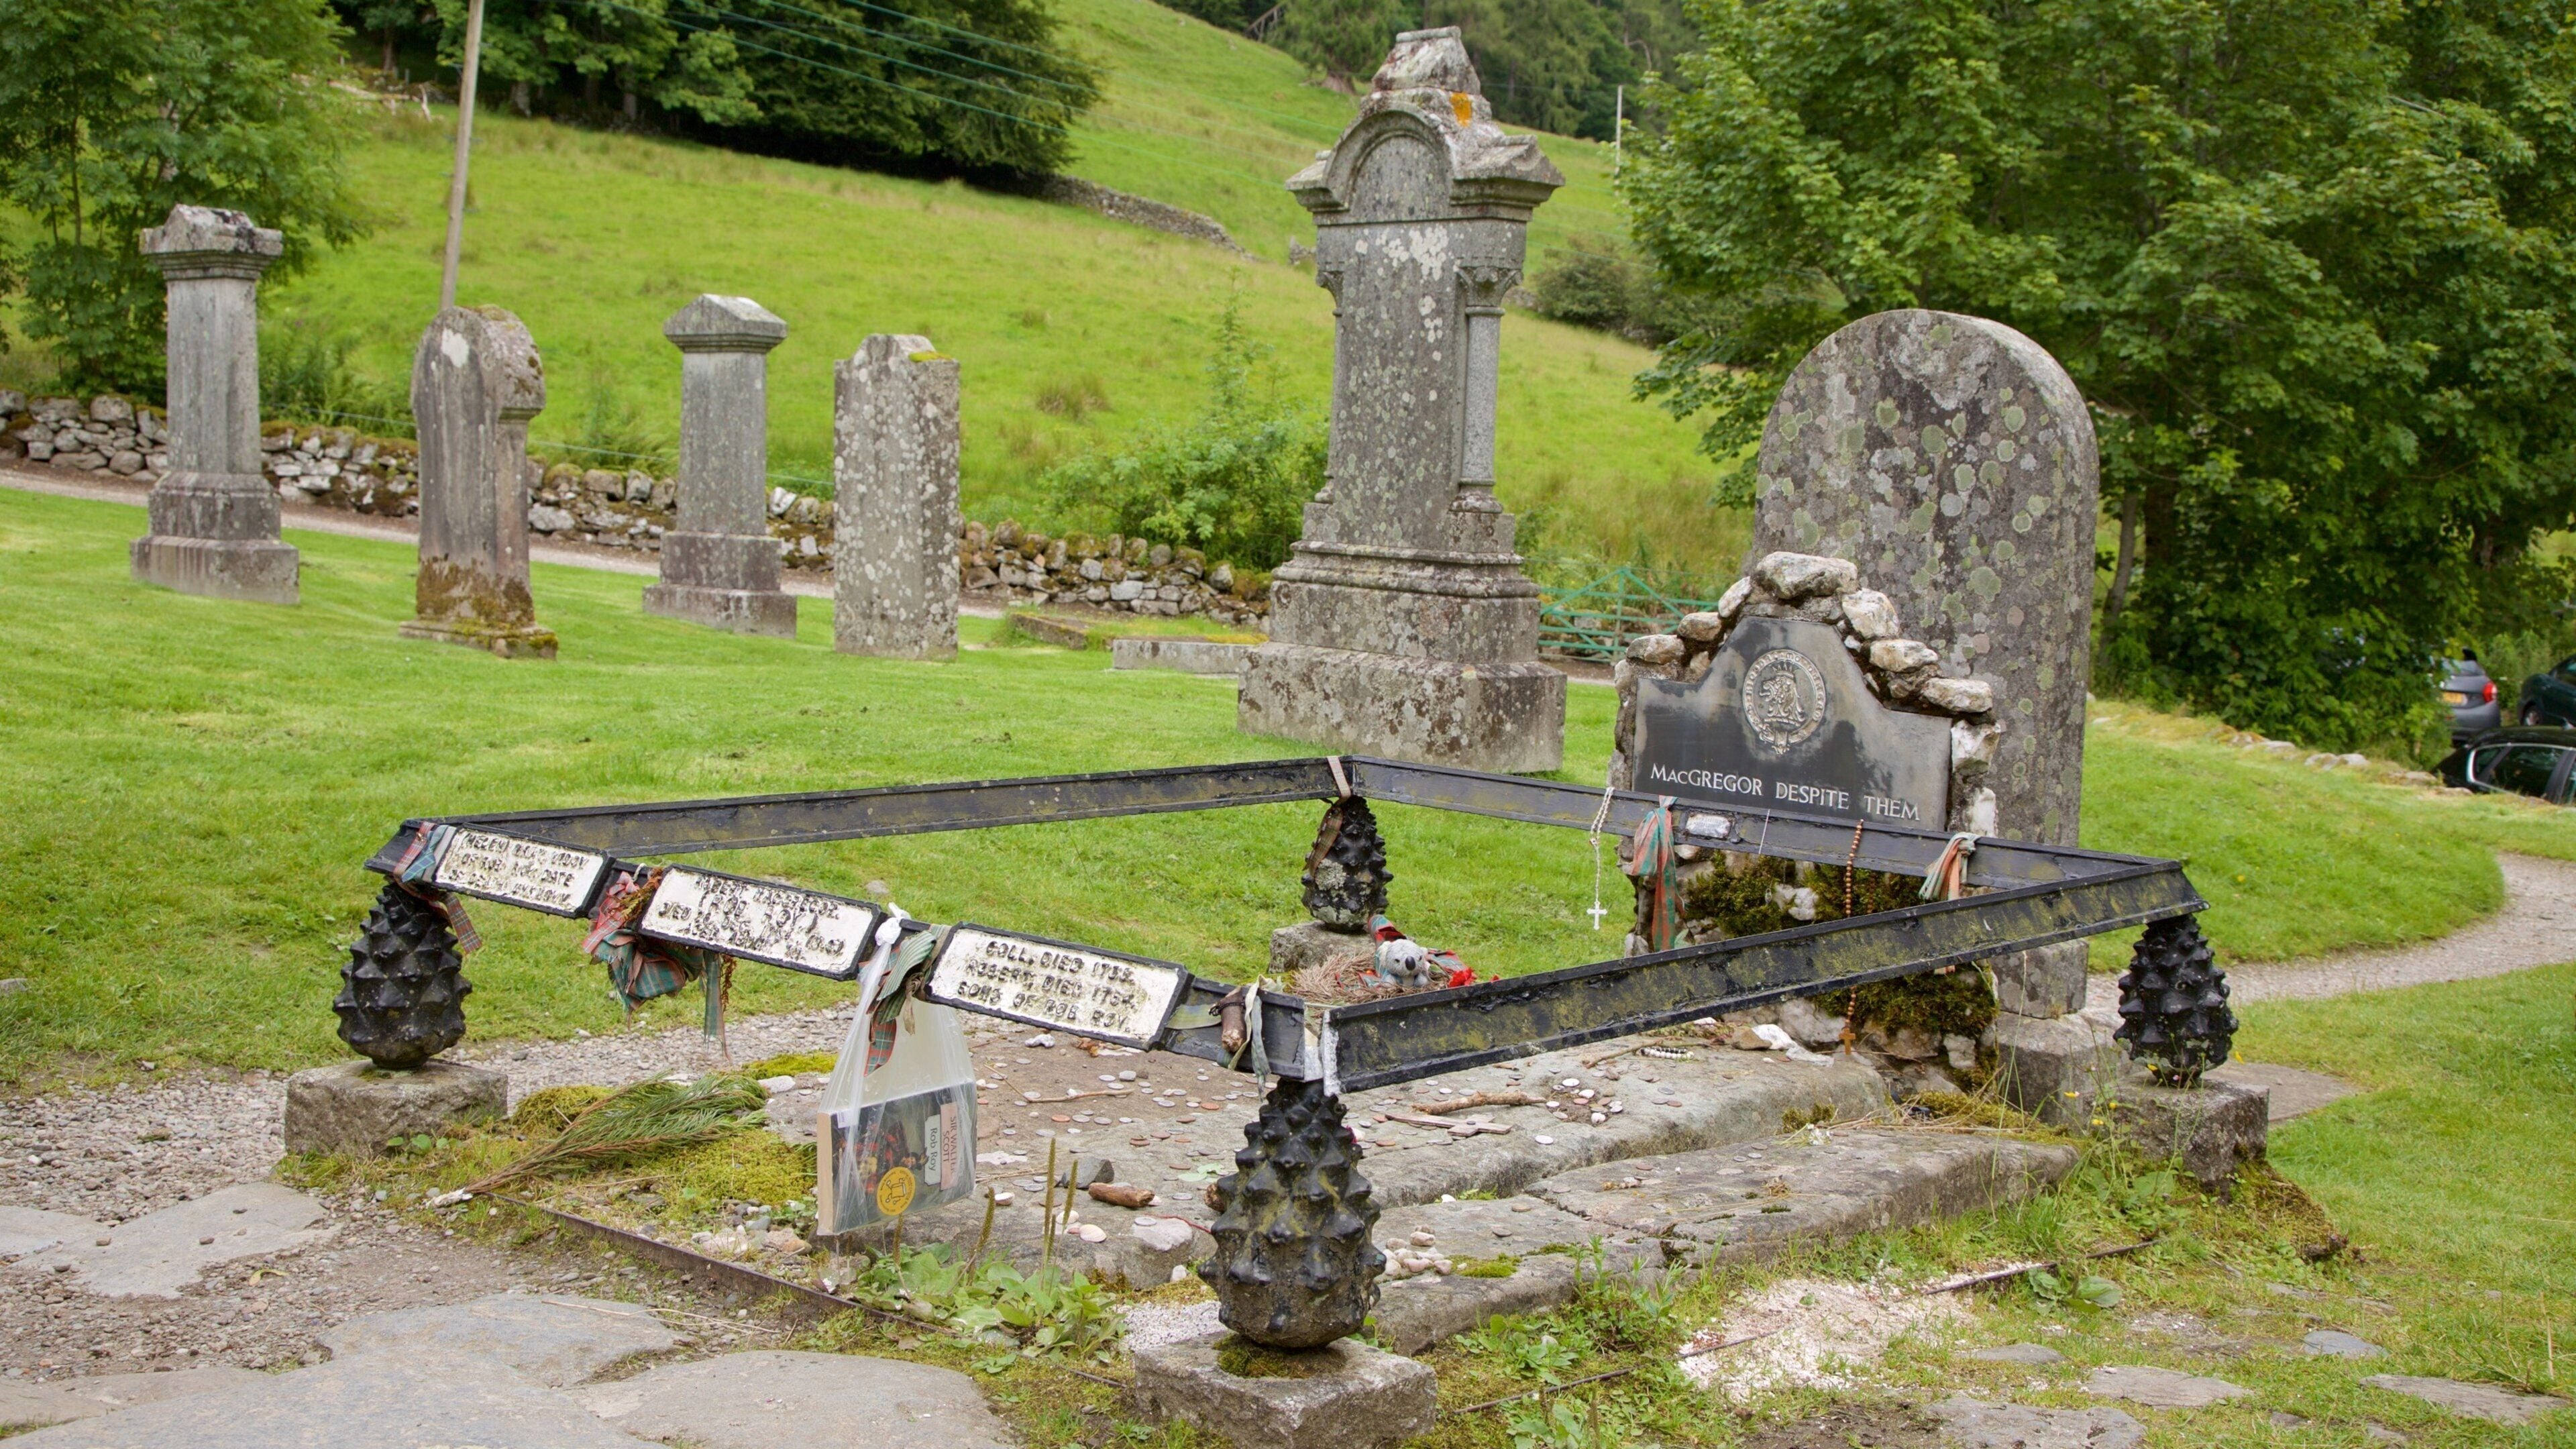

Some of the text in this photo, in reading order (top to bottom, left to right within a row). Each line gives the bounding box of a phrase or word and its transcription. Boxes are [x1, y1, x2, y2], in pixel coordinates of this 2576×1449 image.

[1776, 781, 1849, 810] DESPITE
[1864, 794, 1921, 821] THEM
[541, 869, 576, 888] DATE
[657, 900, 692, 920] DIED
[1040, 951, 1083, 973] DIED
[1042, 975, 1083, 998] DIED
[957, 981, 1002, 1006] SONS
[1013, 993, 1038, 1008] OF
[1043, 999, 1079, 1020] ROB
[928, 1127, 938, 1171] Rob Roy
